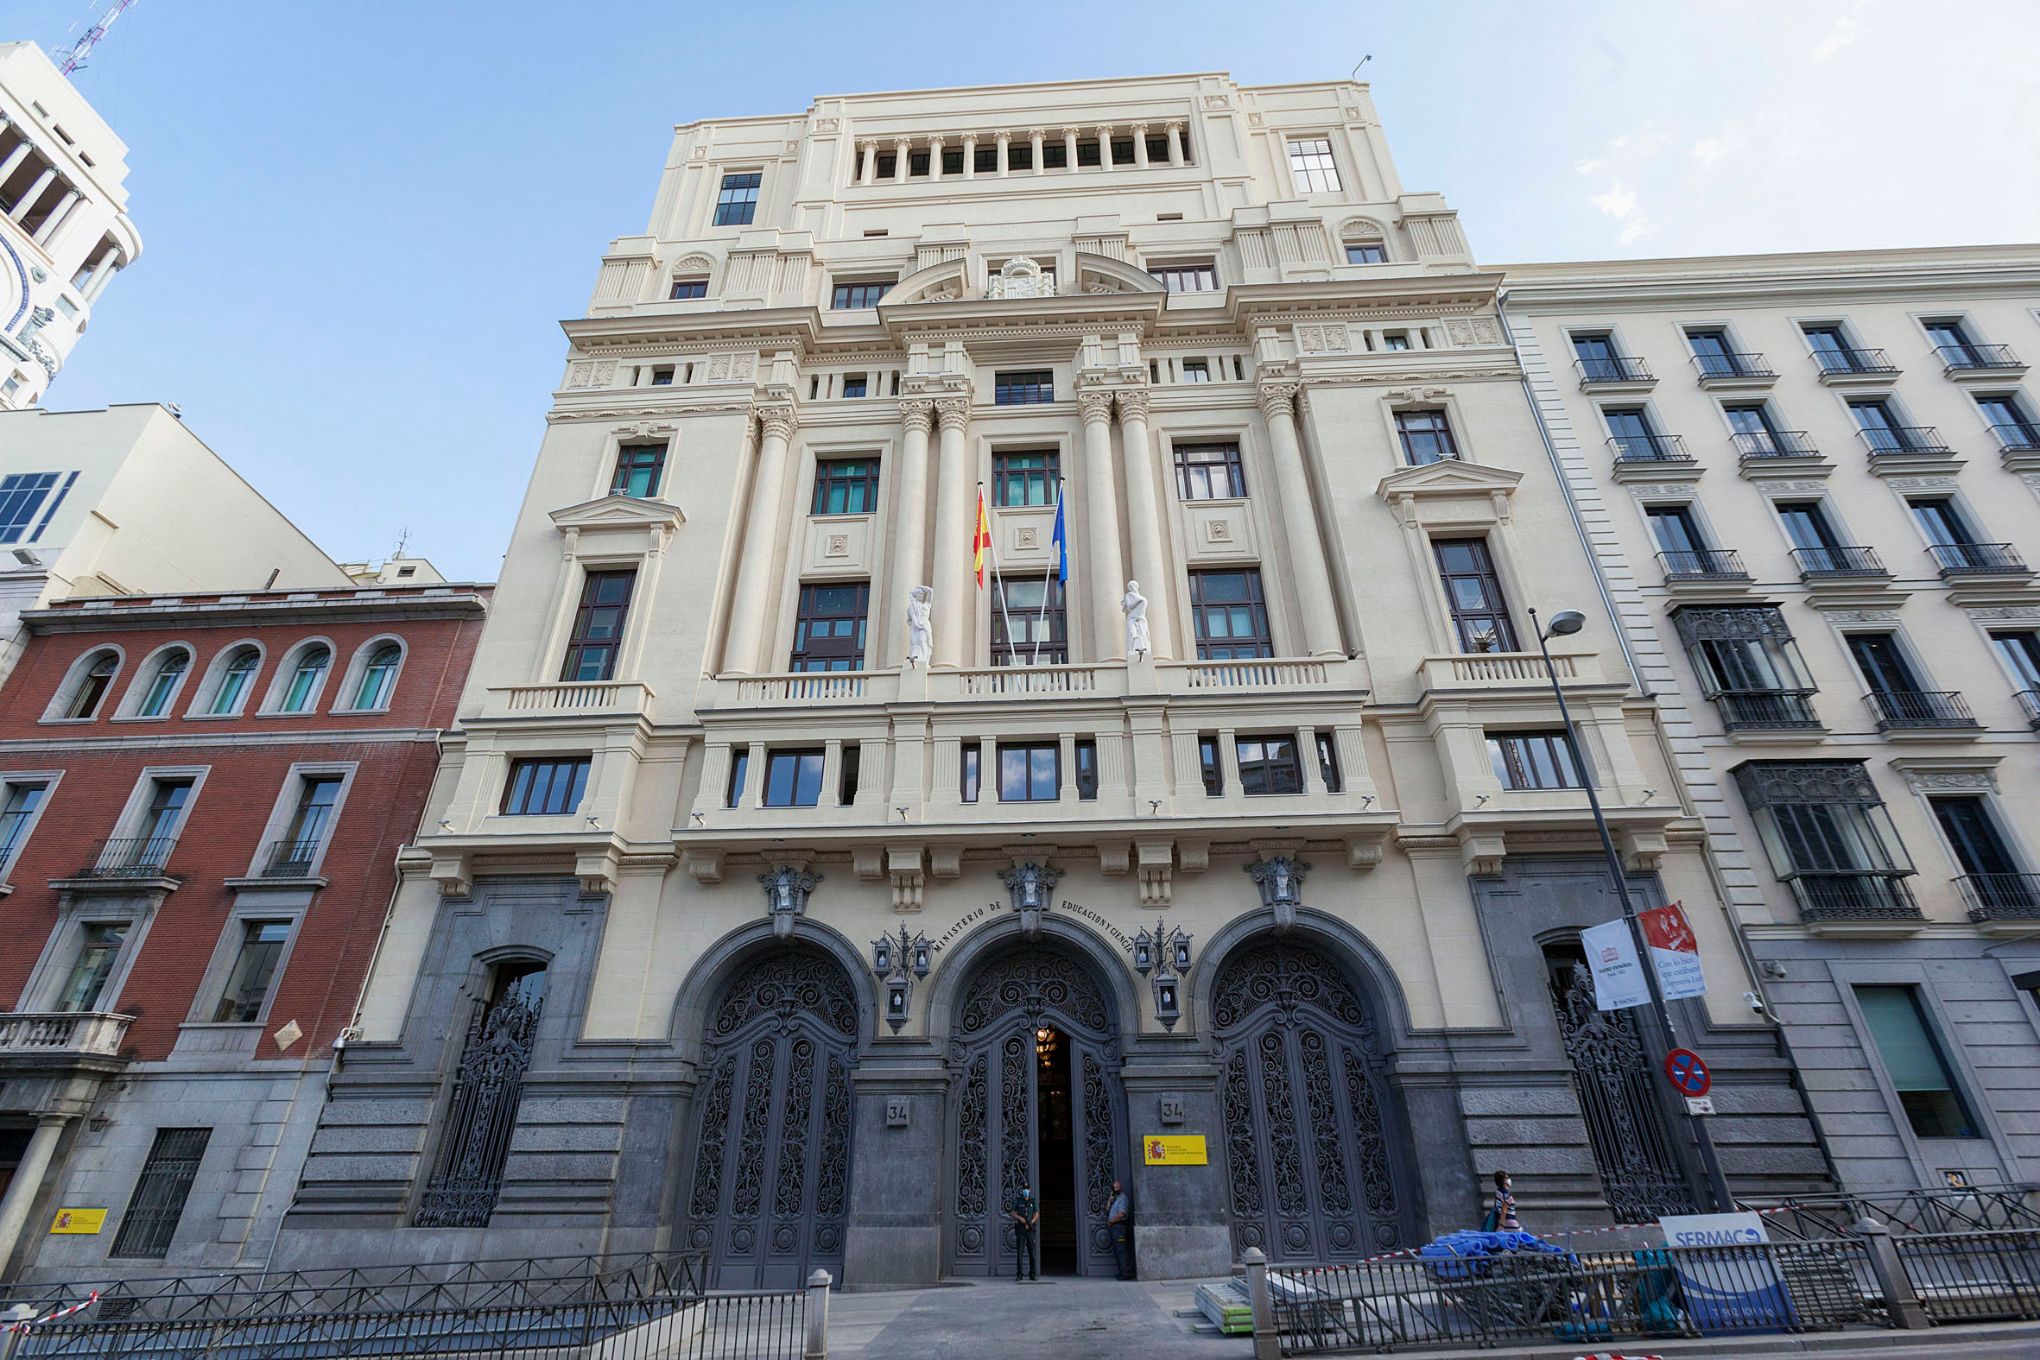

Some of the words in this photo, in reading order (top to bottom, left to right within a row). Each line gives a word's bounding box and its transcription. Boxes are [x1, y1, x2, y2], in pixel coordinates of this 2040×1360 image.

[933, 908, 984, 953] MINISTERIO
[989, 901, 1001, 912] DE
[1061, 900, 1106, 927] EDUCACION
[1105, 922, 1113, 931] Y
[1109, 927, 1133, 954] CIENCIA
[888, 1106, 907, 1120] 34
[1163, 1103, 1182, 1117] 34
